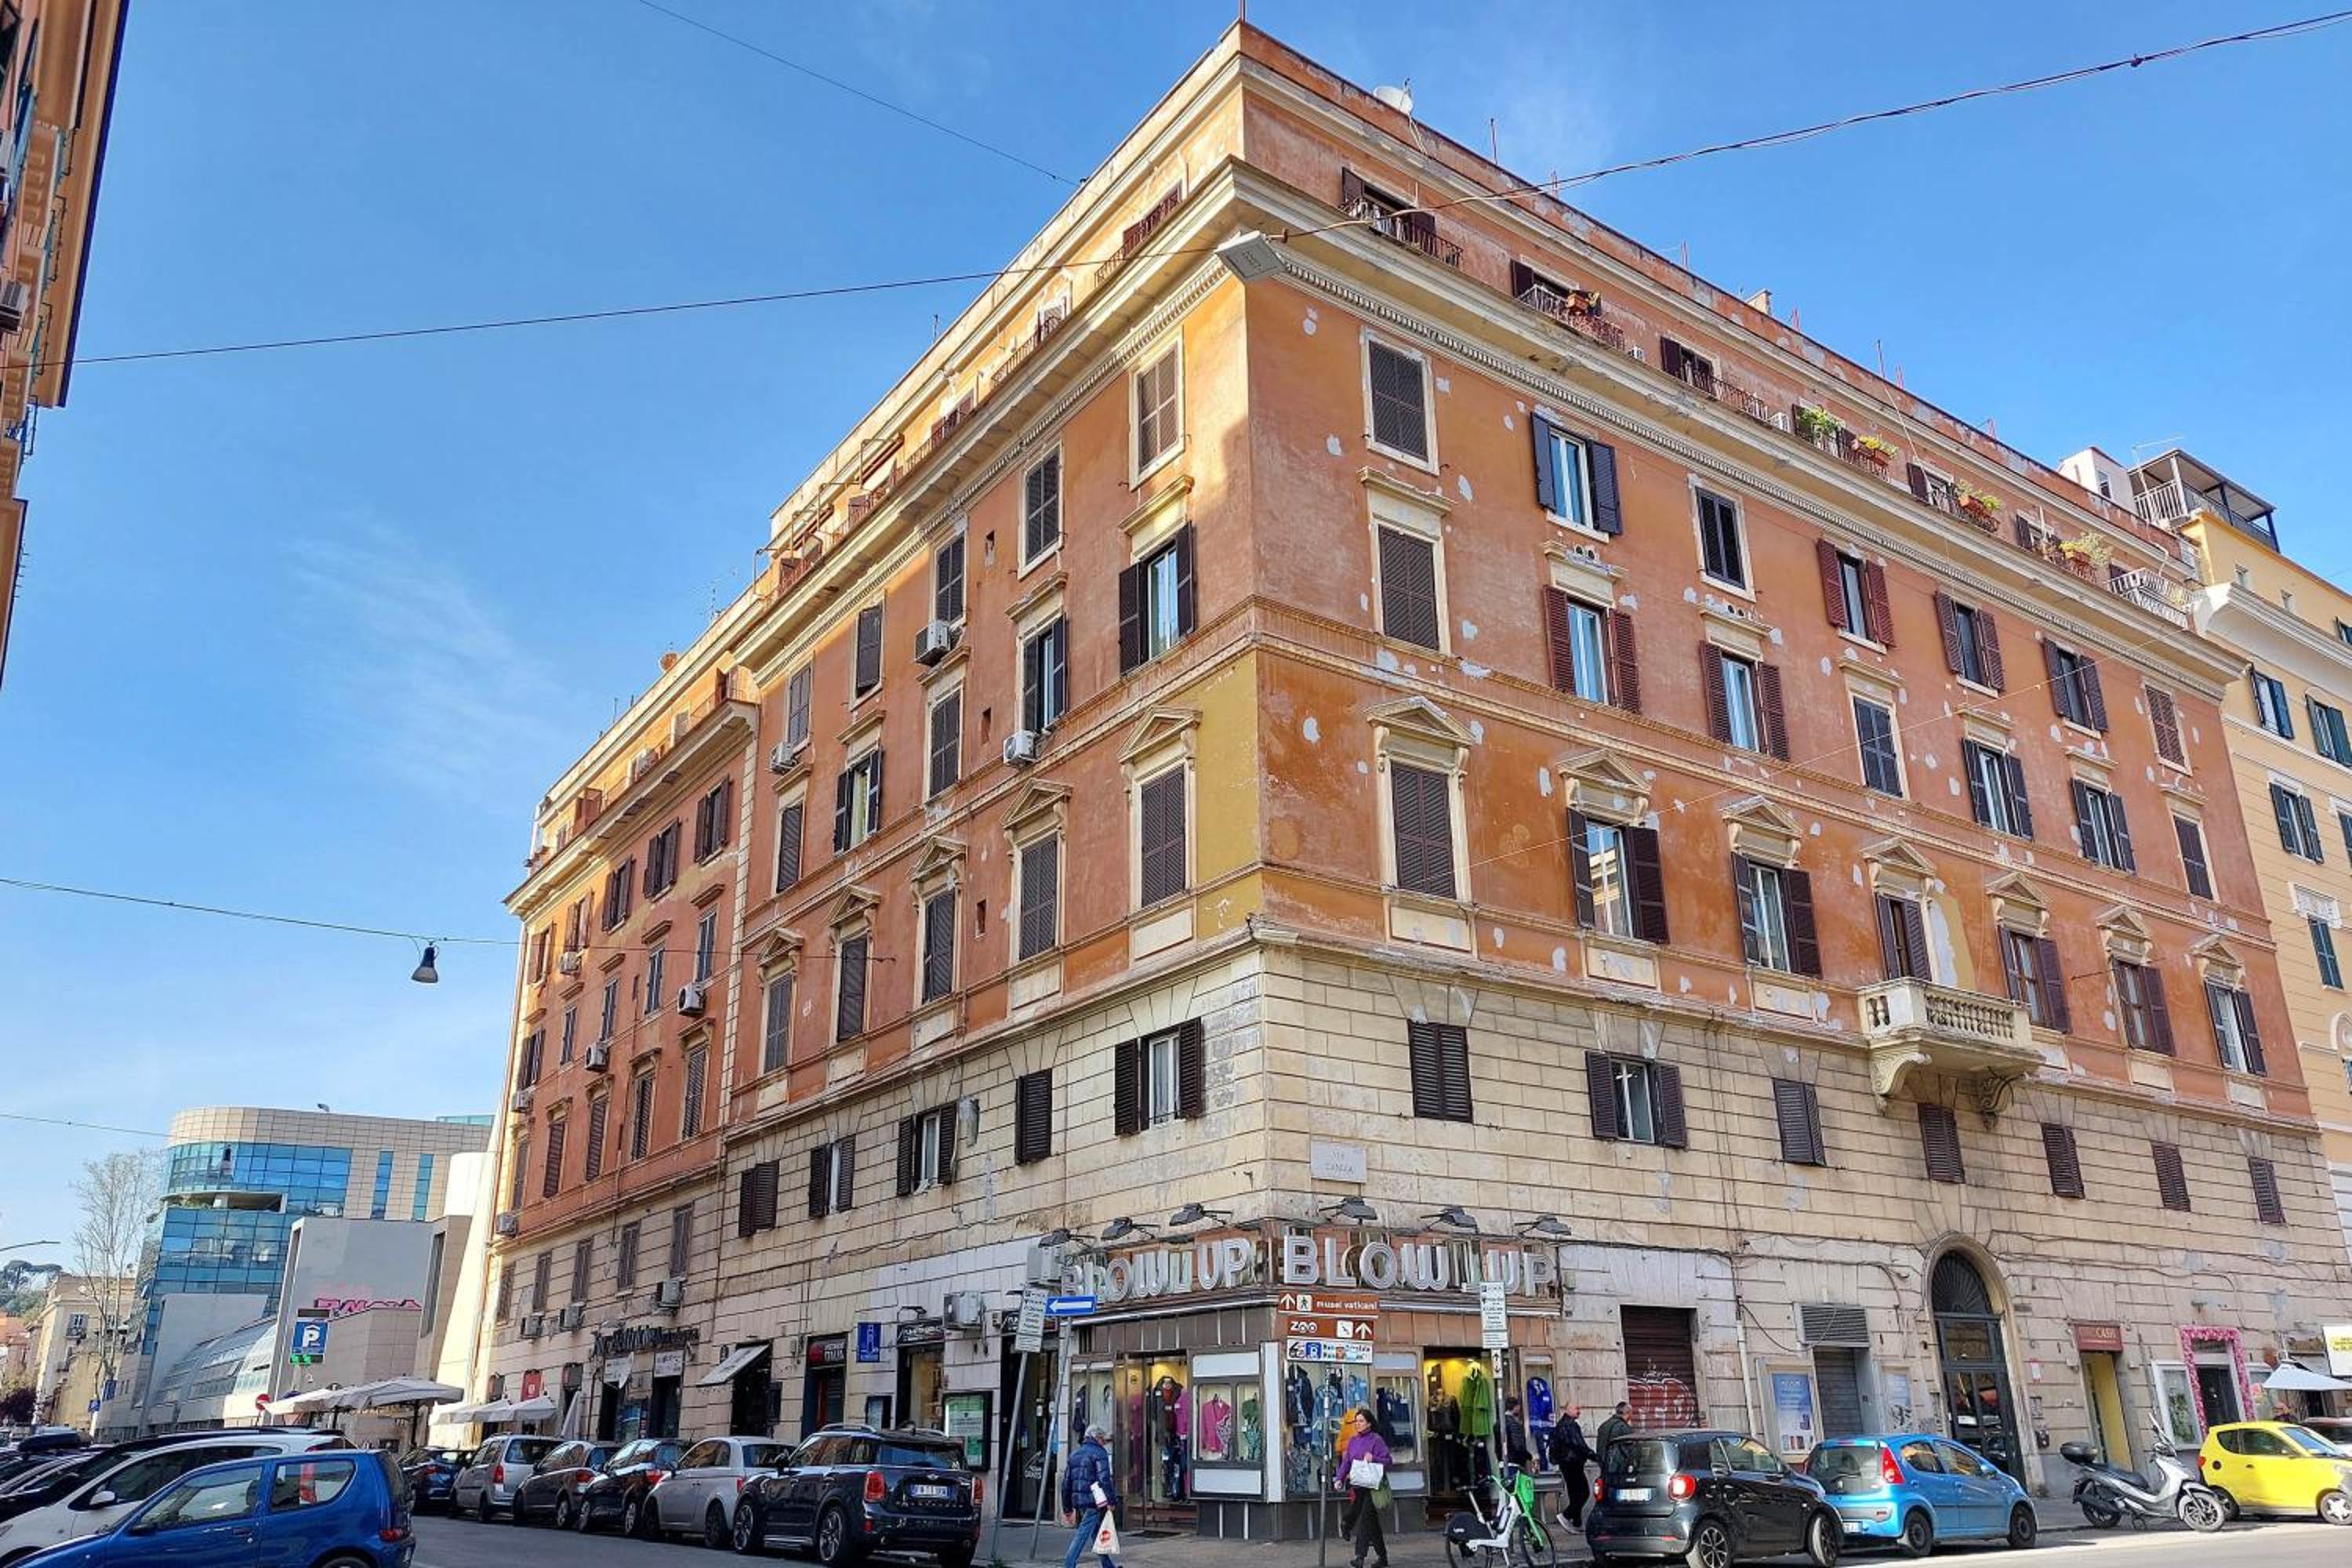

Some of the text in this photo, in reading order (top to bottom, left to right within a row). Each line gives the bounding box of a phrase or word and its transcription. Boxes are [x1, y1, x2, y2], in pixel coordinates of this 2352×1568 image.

[1198, 1238, 1250, 1290] UP
[1284, 1236, 1555, 1297] BLOW UP
